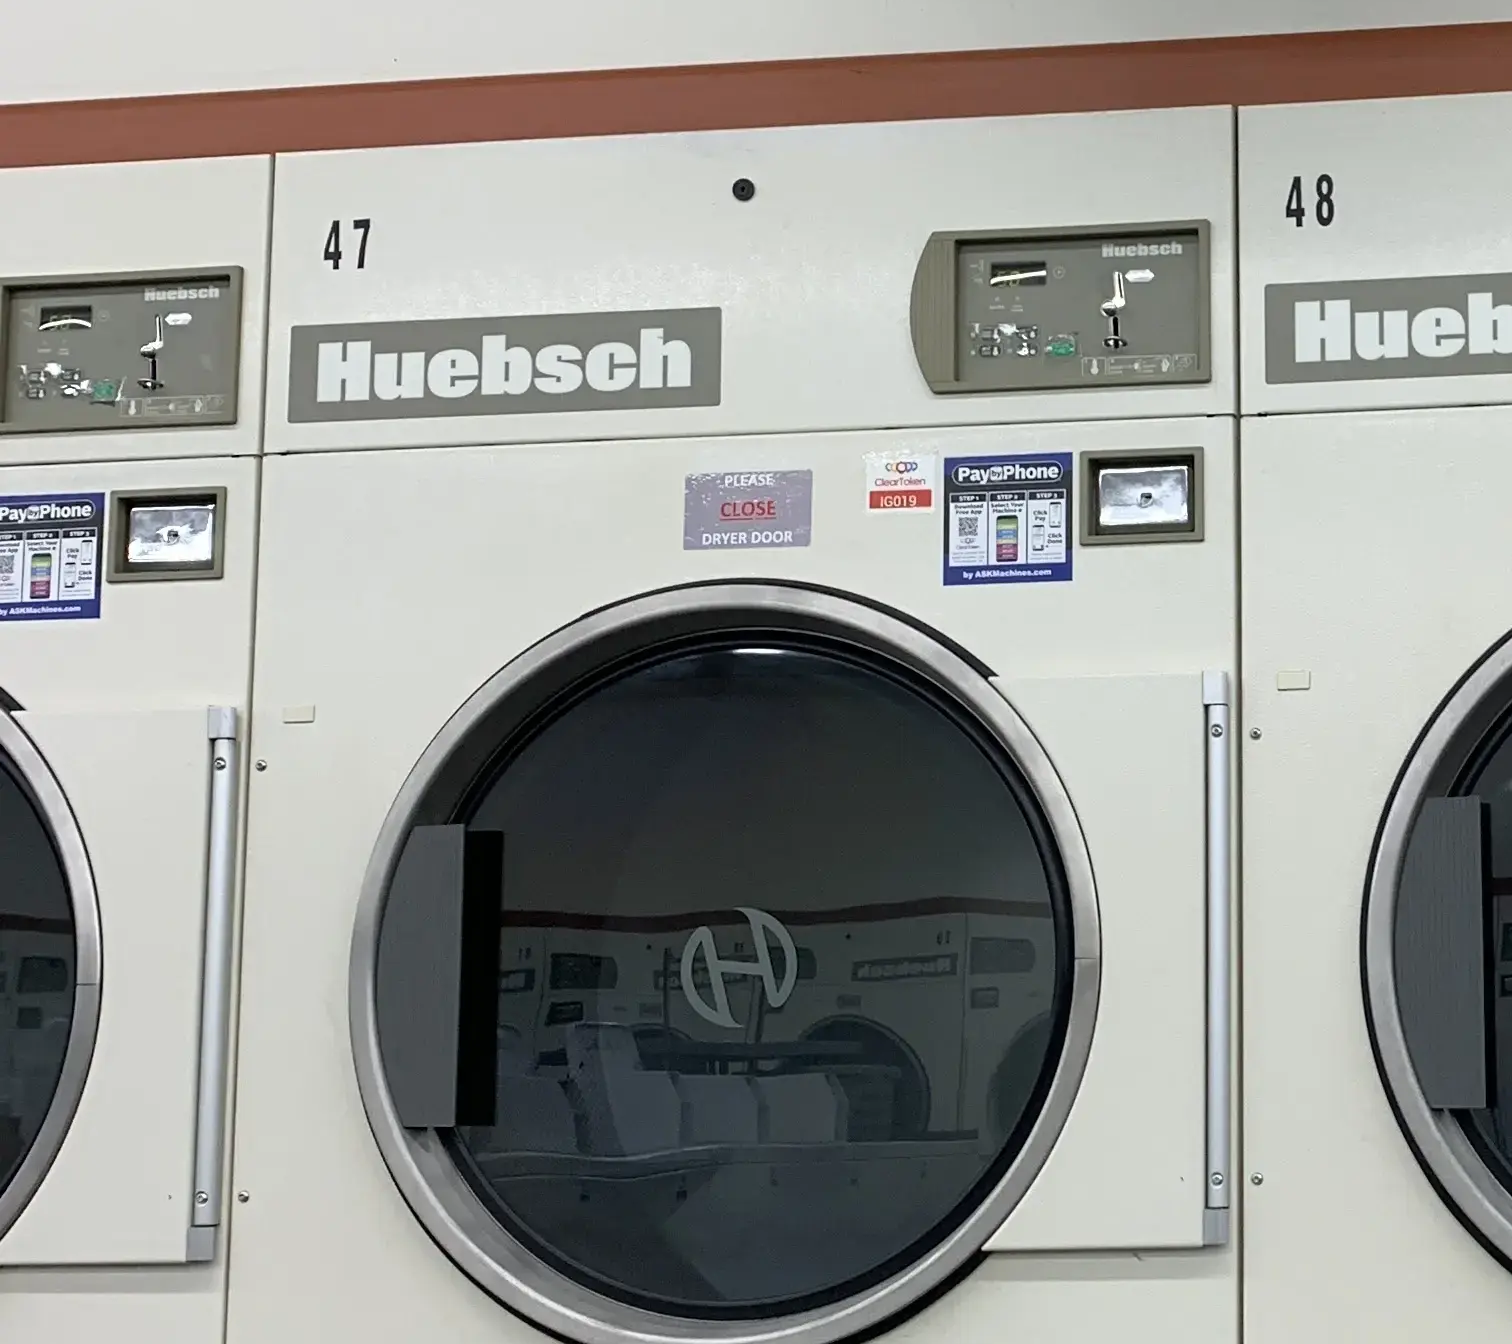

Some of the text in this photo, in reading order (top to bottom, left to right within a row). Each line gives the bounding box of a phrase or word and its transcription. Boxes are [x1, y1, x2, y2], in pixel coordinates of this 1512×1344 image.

[1285, 174, 1335, 227] 48
[323, 218, 371, 270] 47
[1102, 242, 1182, 257] Huebsch
[144, 287, 220, 301] Huebsch
[316, 328, 693, 403] Huebsch
[1003, 464, 1059, 480] Phone
[724, 474, 776, 487] PLEASE
[875, 477, 926, 487] ClearToken
[880, 495, 917, 508] IG019
[40, 504, 92, 519] Phone
[720, 500, 777, 519] CLOSE
[702, 531, 793, 545] DRYER DOOR
[963, 568, 1052, 580] by ASKMachines.com
